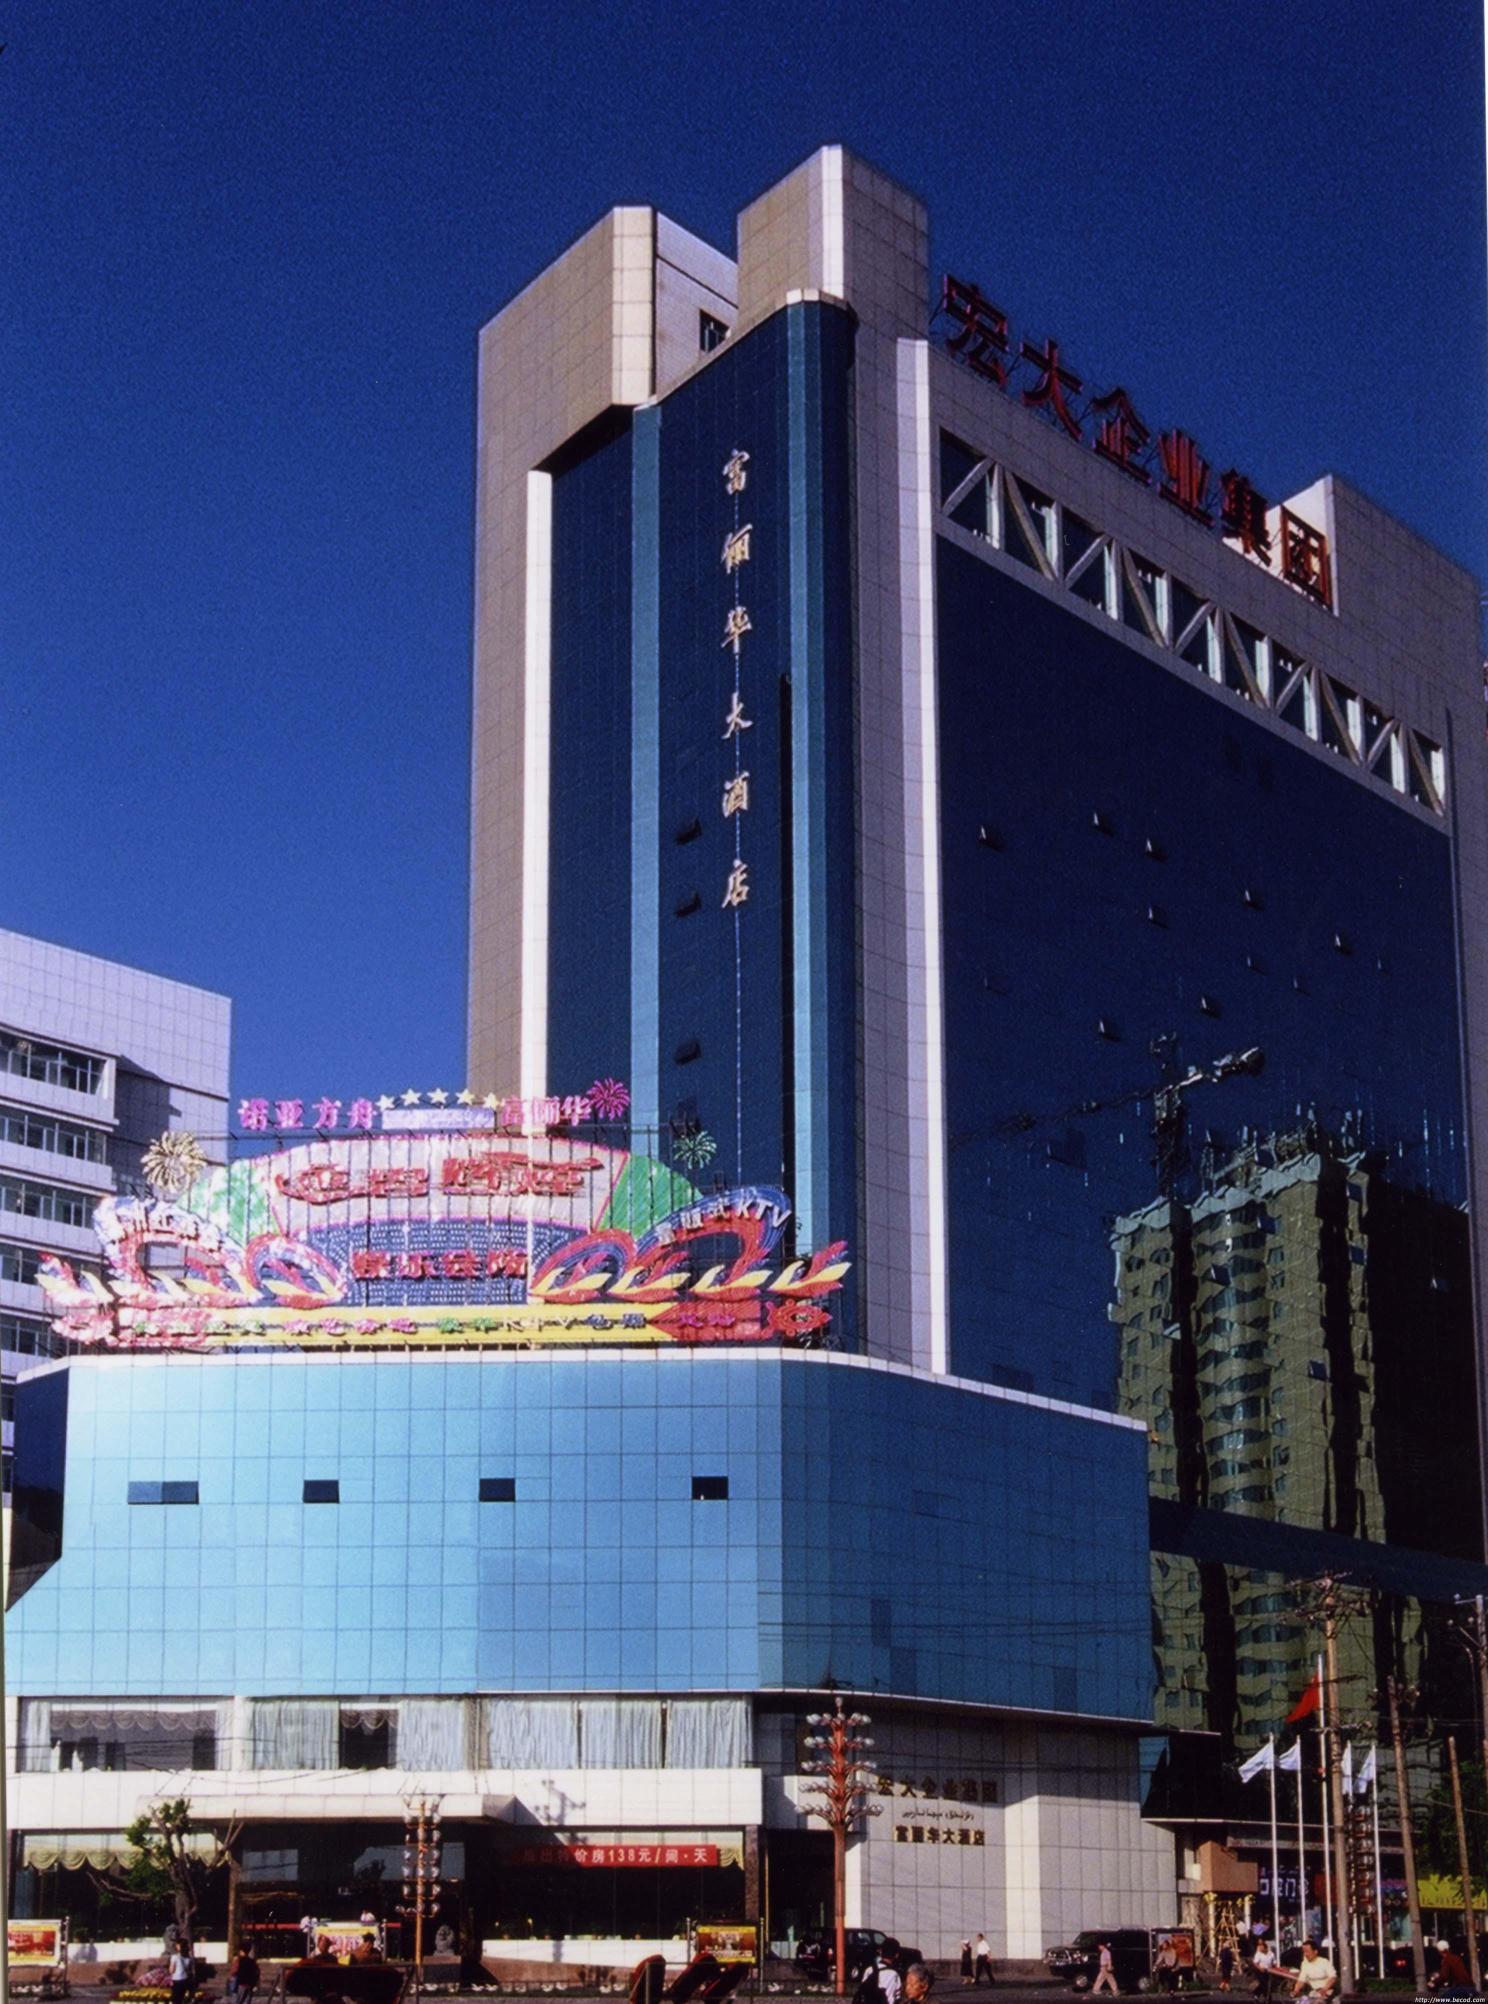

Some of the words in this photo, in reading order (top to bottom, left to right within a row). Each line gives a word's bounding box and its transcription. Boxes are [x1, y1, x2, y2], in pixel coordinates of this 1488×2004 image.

[942, 274, 1334, 610] 宏大企业集团
[238, 1096, 378, 1131] 诺亚方舟
[352, 1249, 528, 1281] 娱乐会所
